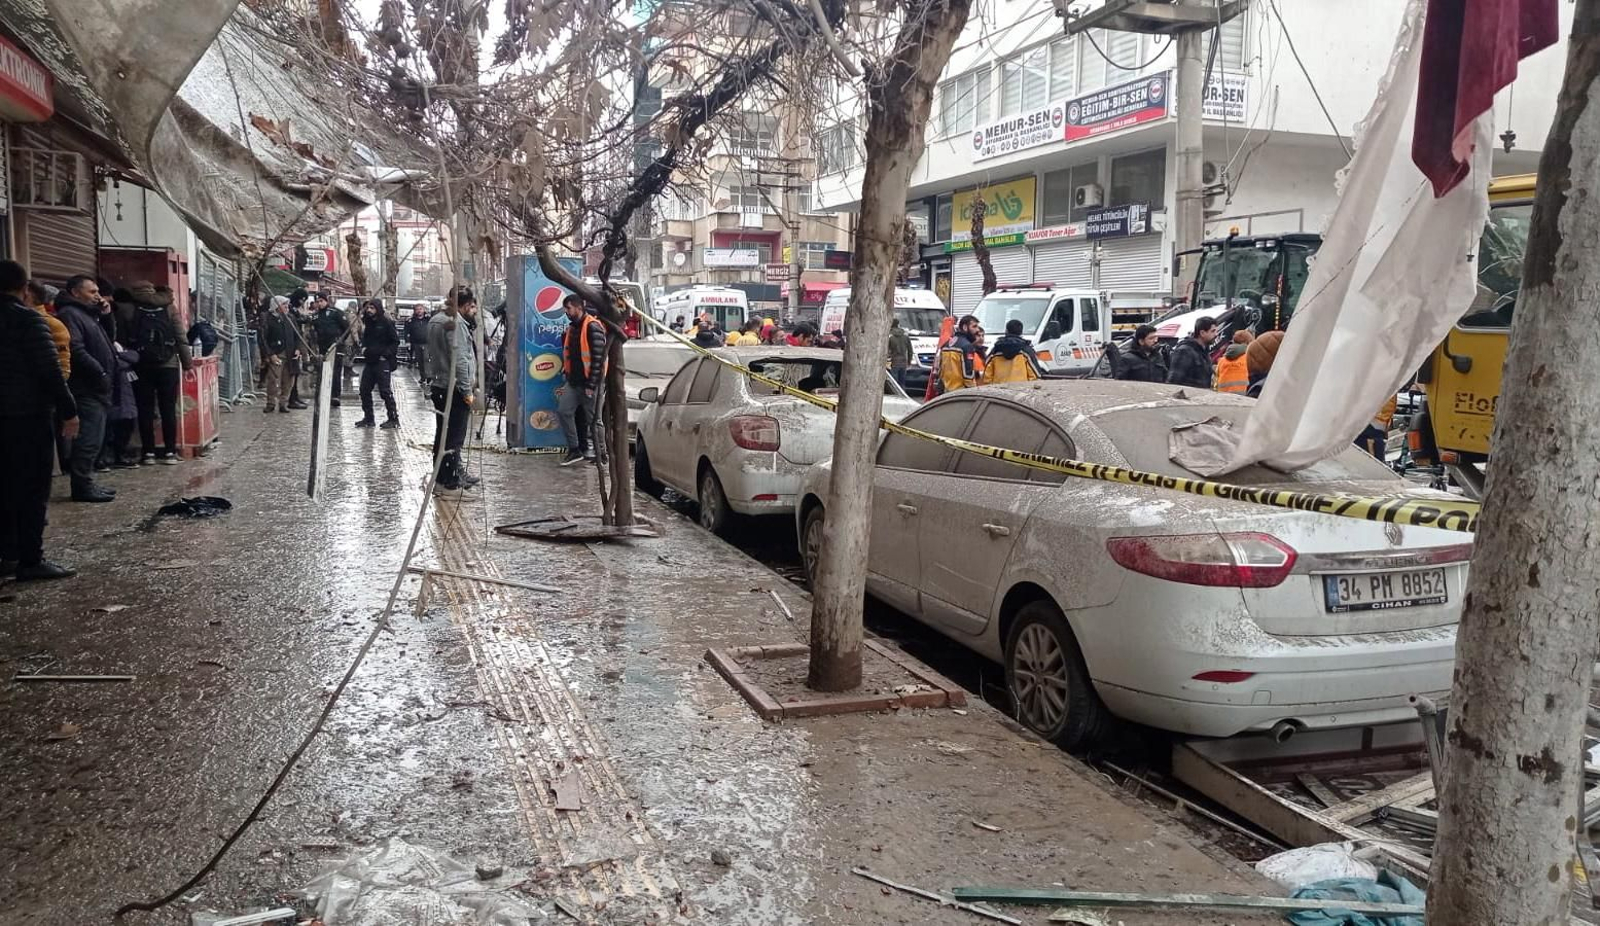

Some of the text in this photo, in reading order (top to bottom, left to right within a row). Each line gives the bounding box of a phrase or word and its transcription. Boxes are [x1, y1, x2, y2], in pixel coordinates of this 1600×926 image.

[985, 109, 1051, 139] MEMUR-SEN
[1339, 577, 1362, 602] 34
[1369, 574, 1393, 600] PM
[1402, 570, 1444, 597] 8852
